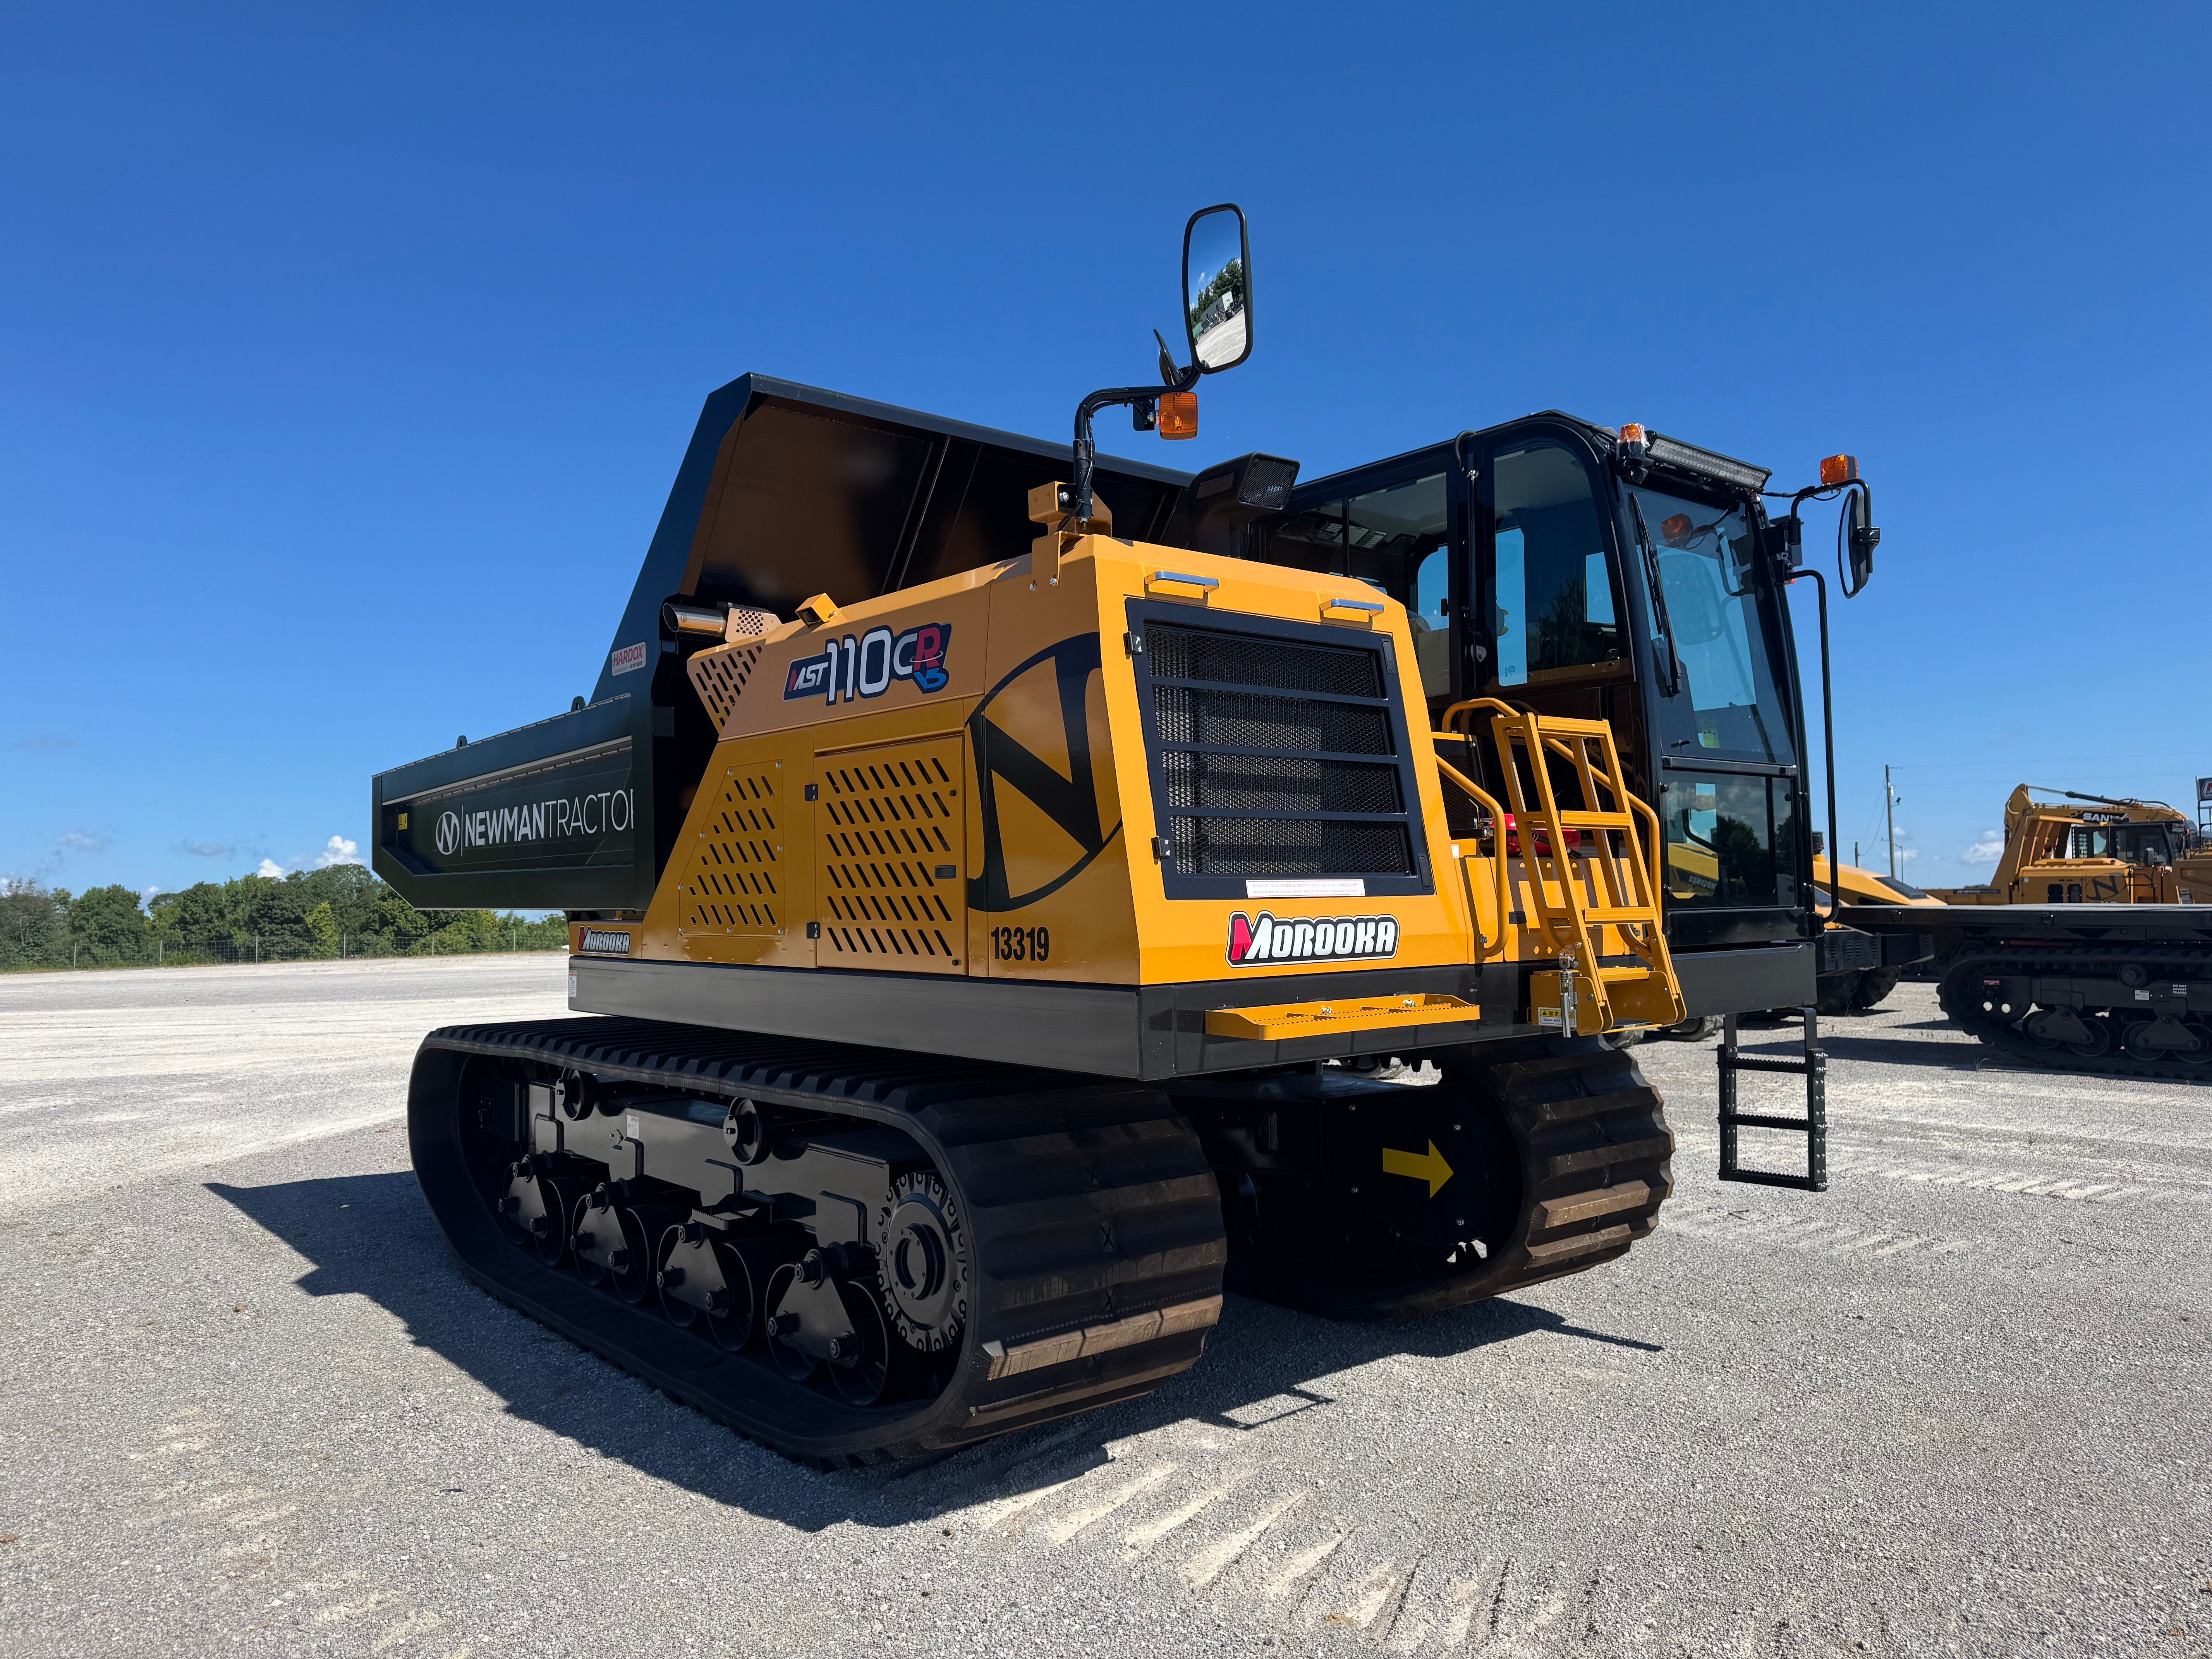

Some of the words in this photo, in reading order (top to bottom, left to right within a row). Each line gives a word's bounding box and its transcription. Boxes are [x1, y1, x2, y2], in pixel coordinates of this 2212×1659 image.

[613, 644, 643, 667] HARDOX
[2083, 812, 2113, 822] SAN
[579, 929, 630, 952] MOROOKA
[991, 927, 1049, 961] 13319
[1231, 918, 1395, 960] MOROOKA
